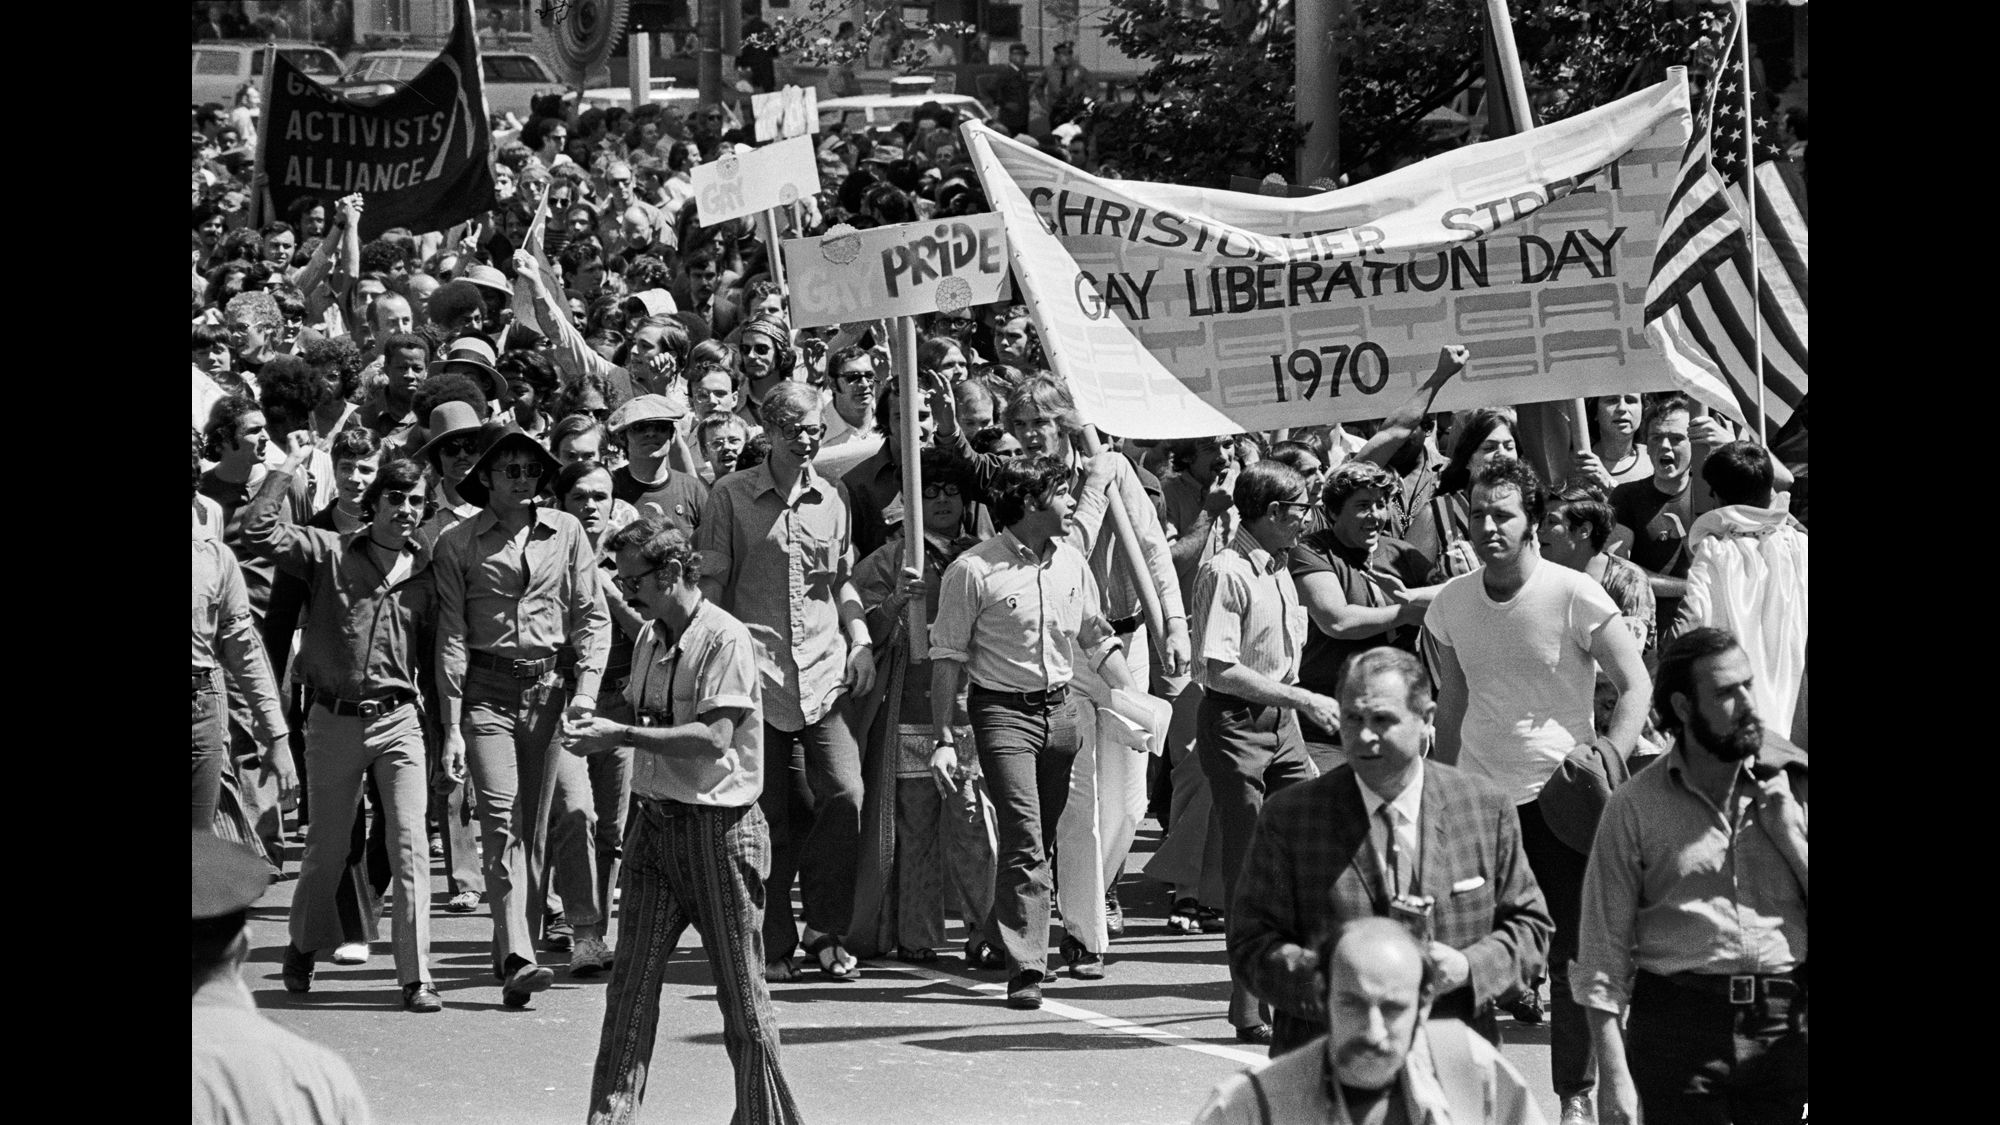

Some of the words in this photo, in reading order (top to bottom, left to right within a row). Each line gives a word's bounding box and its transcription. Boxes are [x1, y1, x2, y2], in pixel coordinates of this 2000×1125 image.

[285, 110, 446, 149] ACTIVISTS
[284, 154, 426, 193] ALLIANCE
[701, 176, 746, 215] GAY
[1074, 270, 1159, 321] GAY
[1184, 239, 1492, 317] LIBERATION
[1517, 226, 1628, 285] DAY
[1270, 342, 1390, 403] 1970
